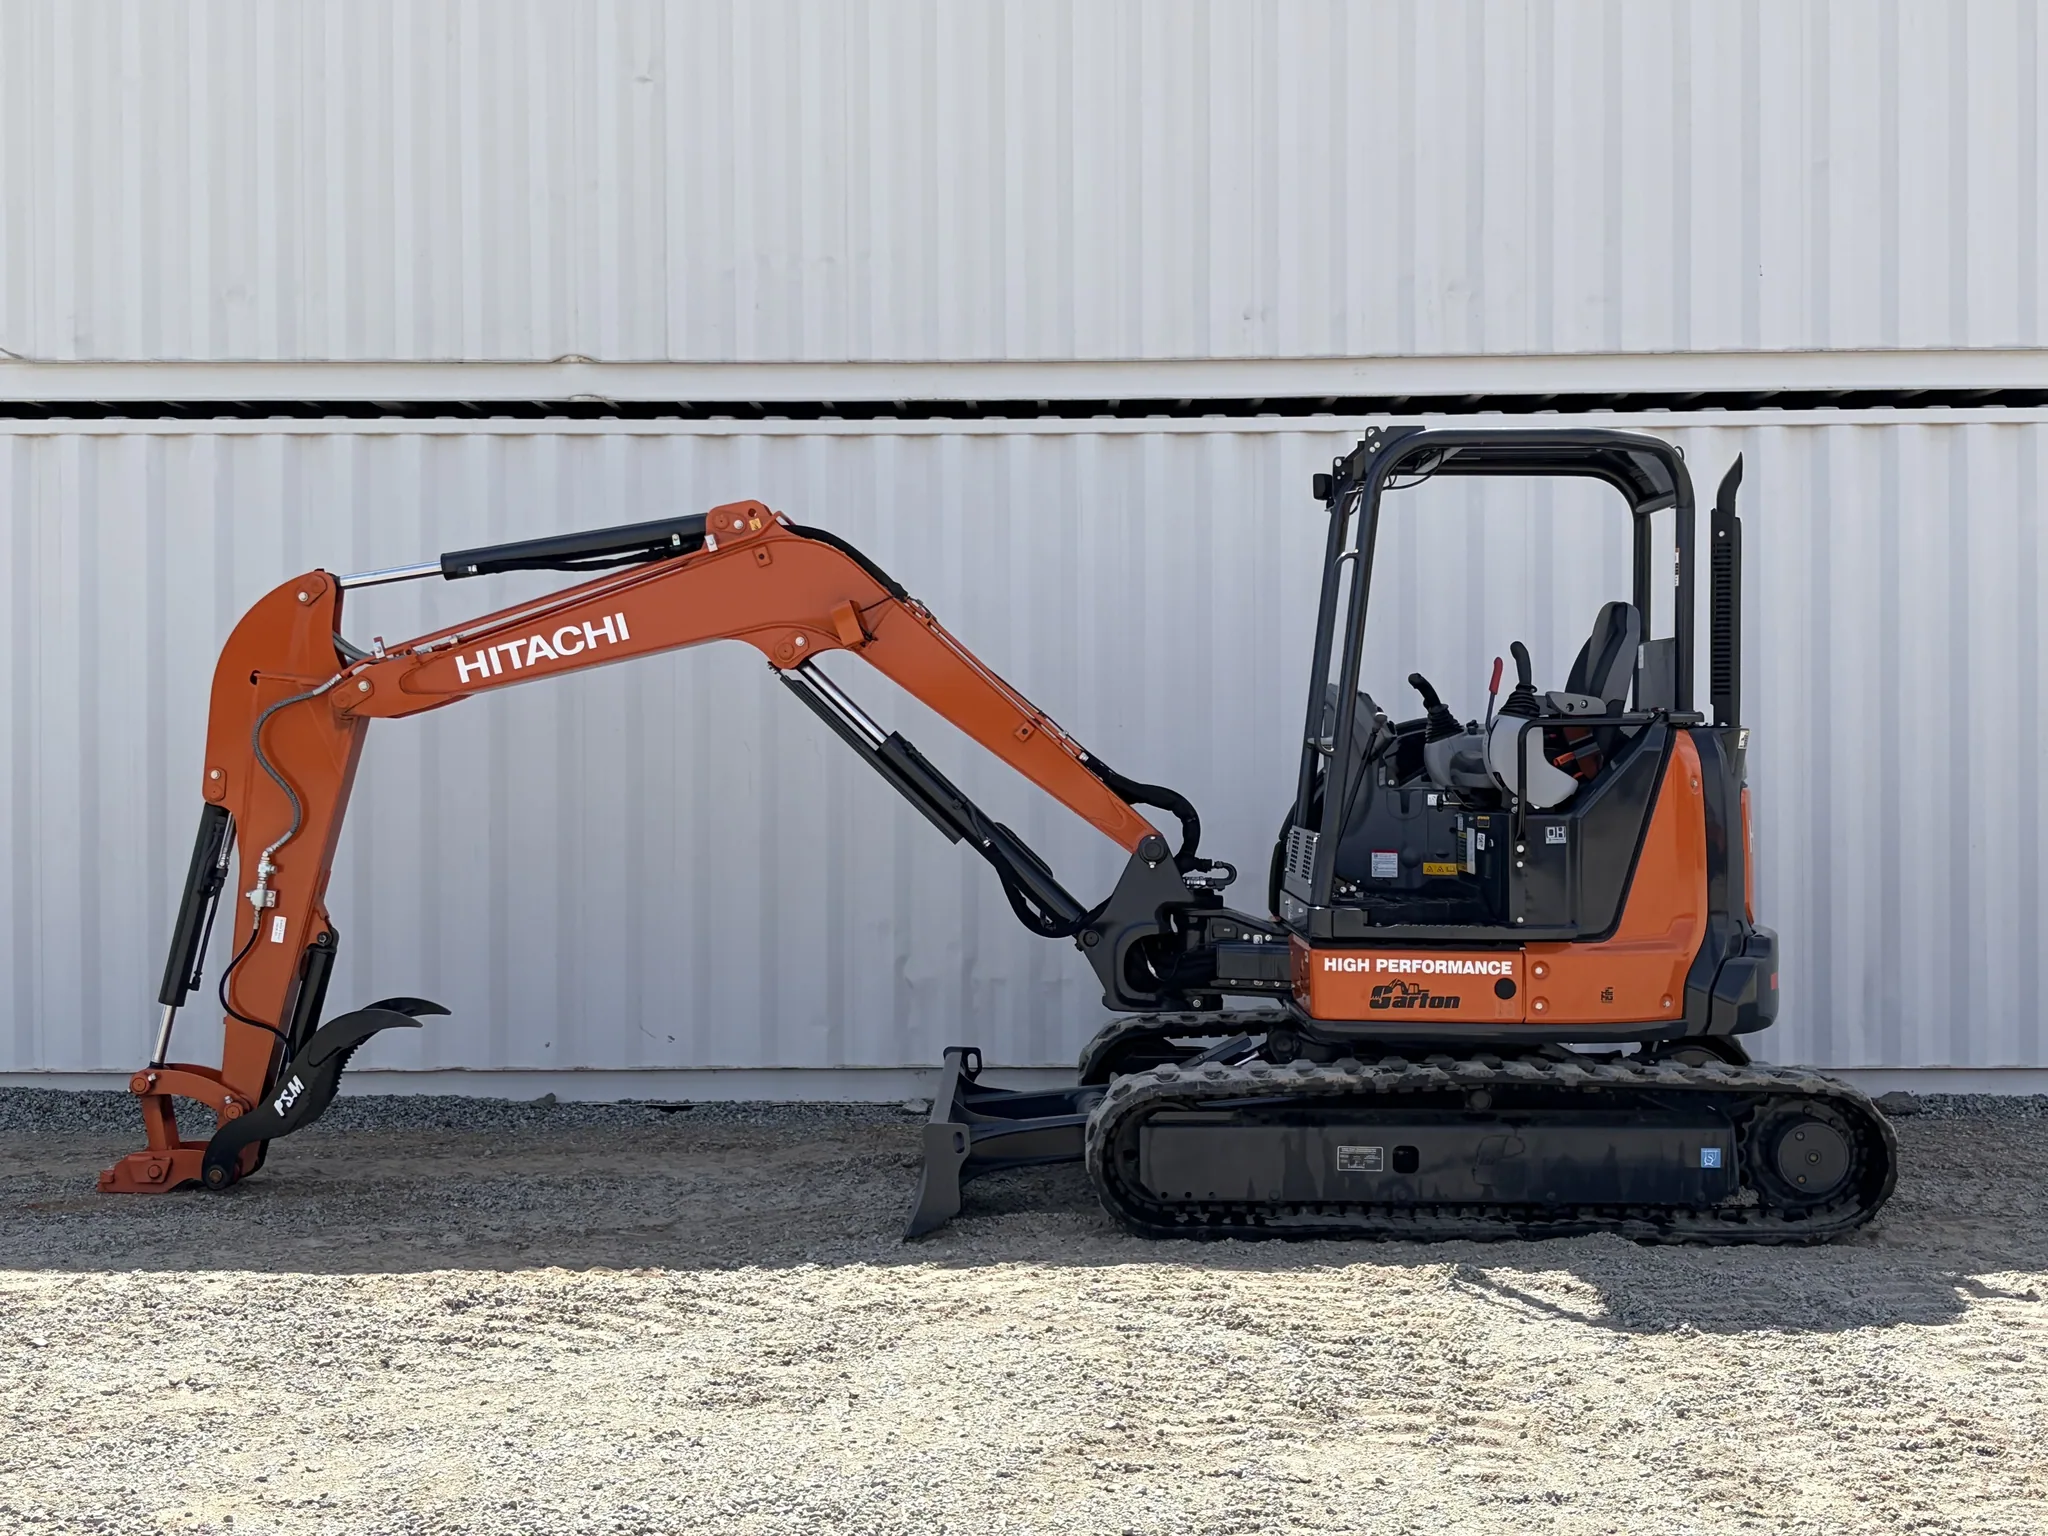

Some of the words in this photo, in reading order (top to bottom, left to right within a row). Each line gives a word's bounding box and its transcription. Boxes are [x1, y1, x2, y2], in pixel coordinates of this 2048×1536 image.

[455, 612, 630, 684] HITACHI
[1324, 958, 1370, 972] HIGH
[1376, 959, 1512, 975] PERFORMANCE
[1369, 985, 1460, 1009] Garton
[273, 1075, 305, 1117] PSM
